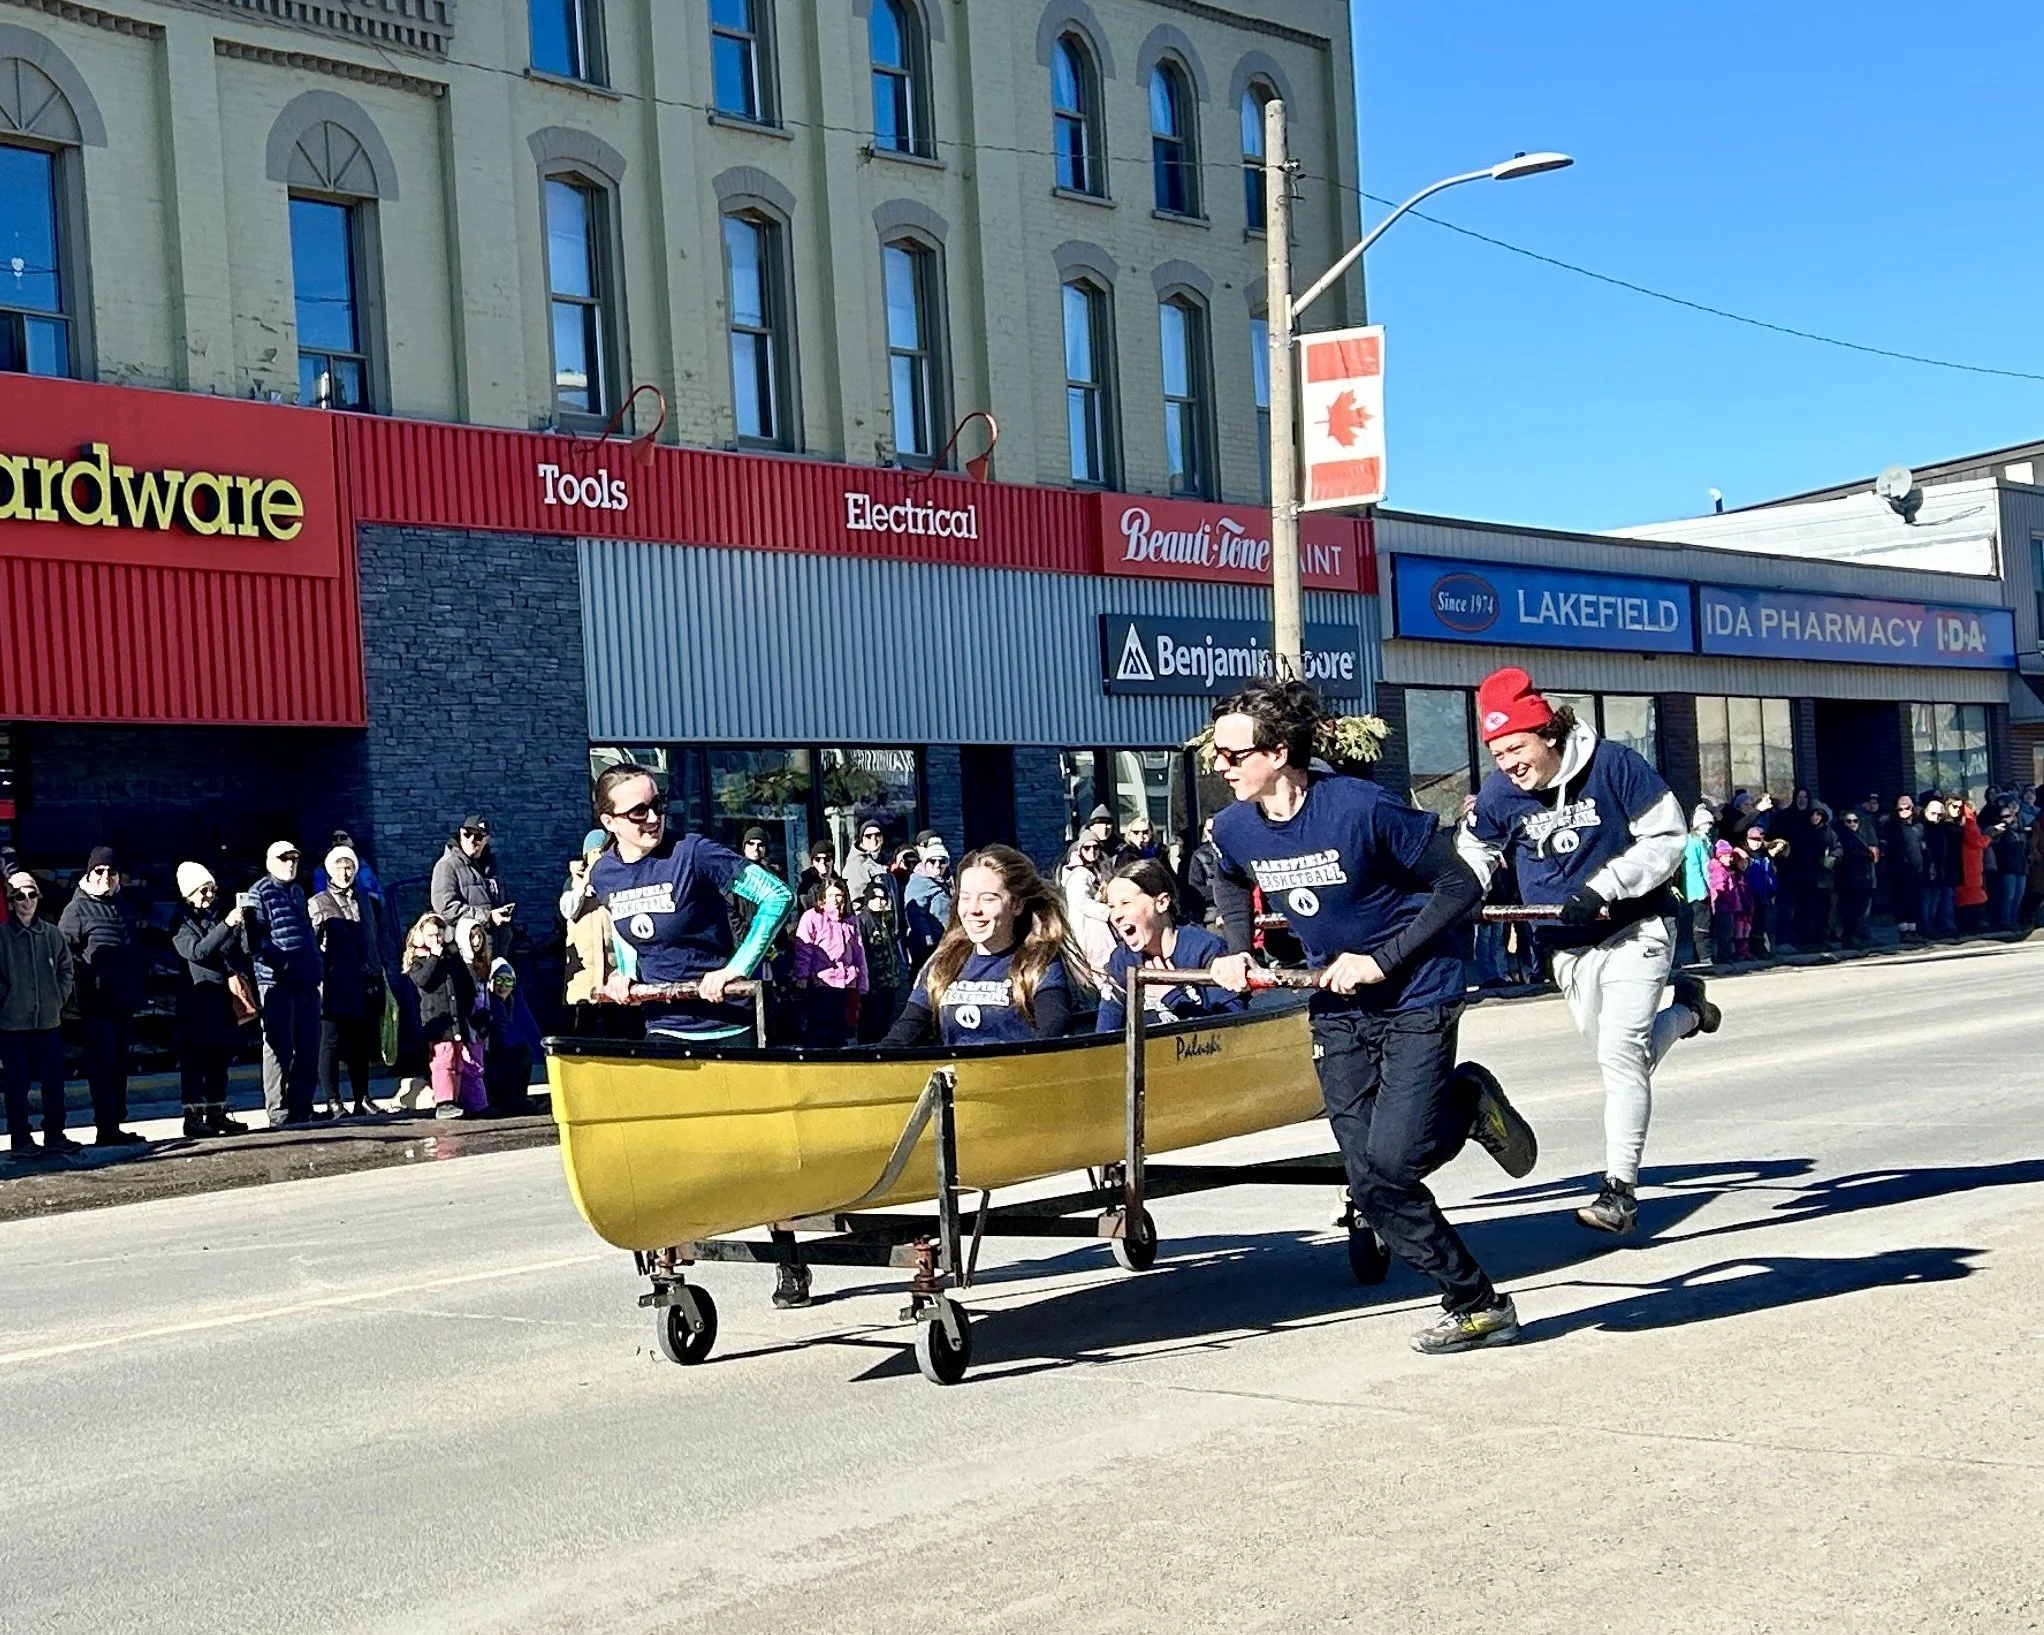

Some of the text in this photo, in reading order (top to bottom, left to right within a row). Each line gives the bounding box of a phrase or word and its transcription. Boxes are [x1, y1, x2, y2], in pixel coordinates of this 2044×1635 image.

[537, 463, 629, 511] Tools
[844, 492, 979, 540] Electrical
[1437, 590, 1495, 614] Since 1974
[1517, 589, 1679, 633] LAKEFIELD
[1705, 603, 1922, 648] IDA PHARMACY
[1157, 635, 1353, 688] Benjamin oore
[1251, 849, 1340, 873] LAKEFIELD
[1255, 863, 1348, 893] BASKETBALL
